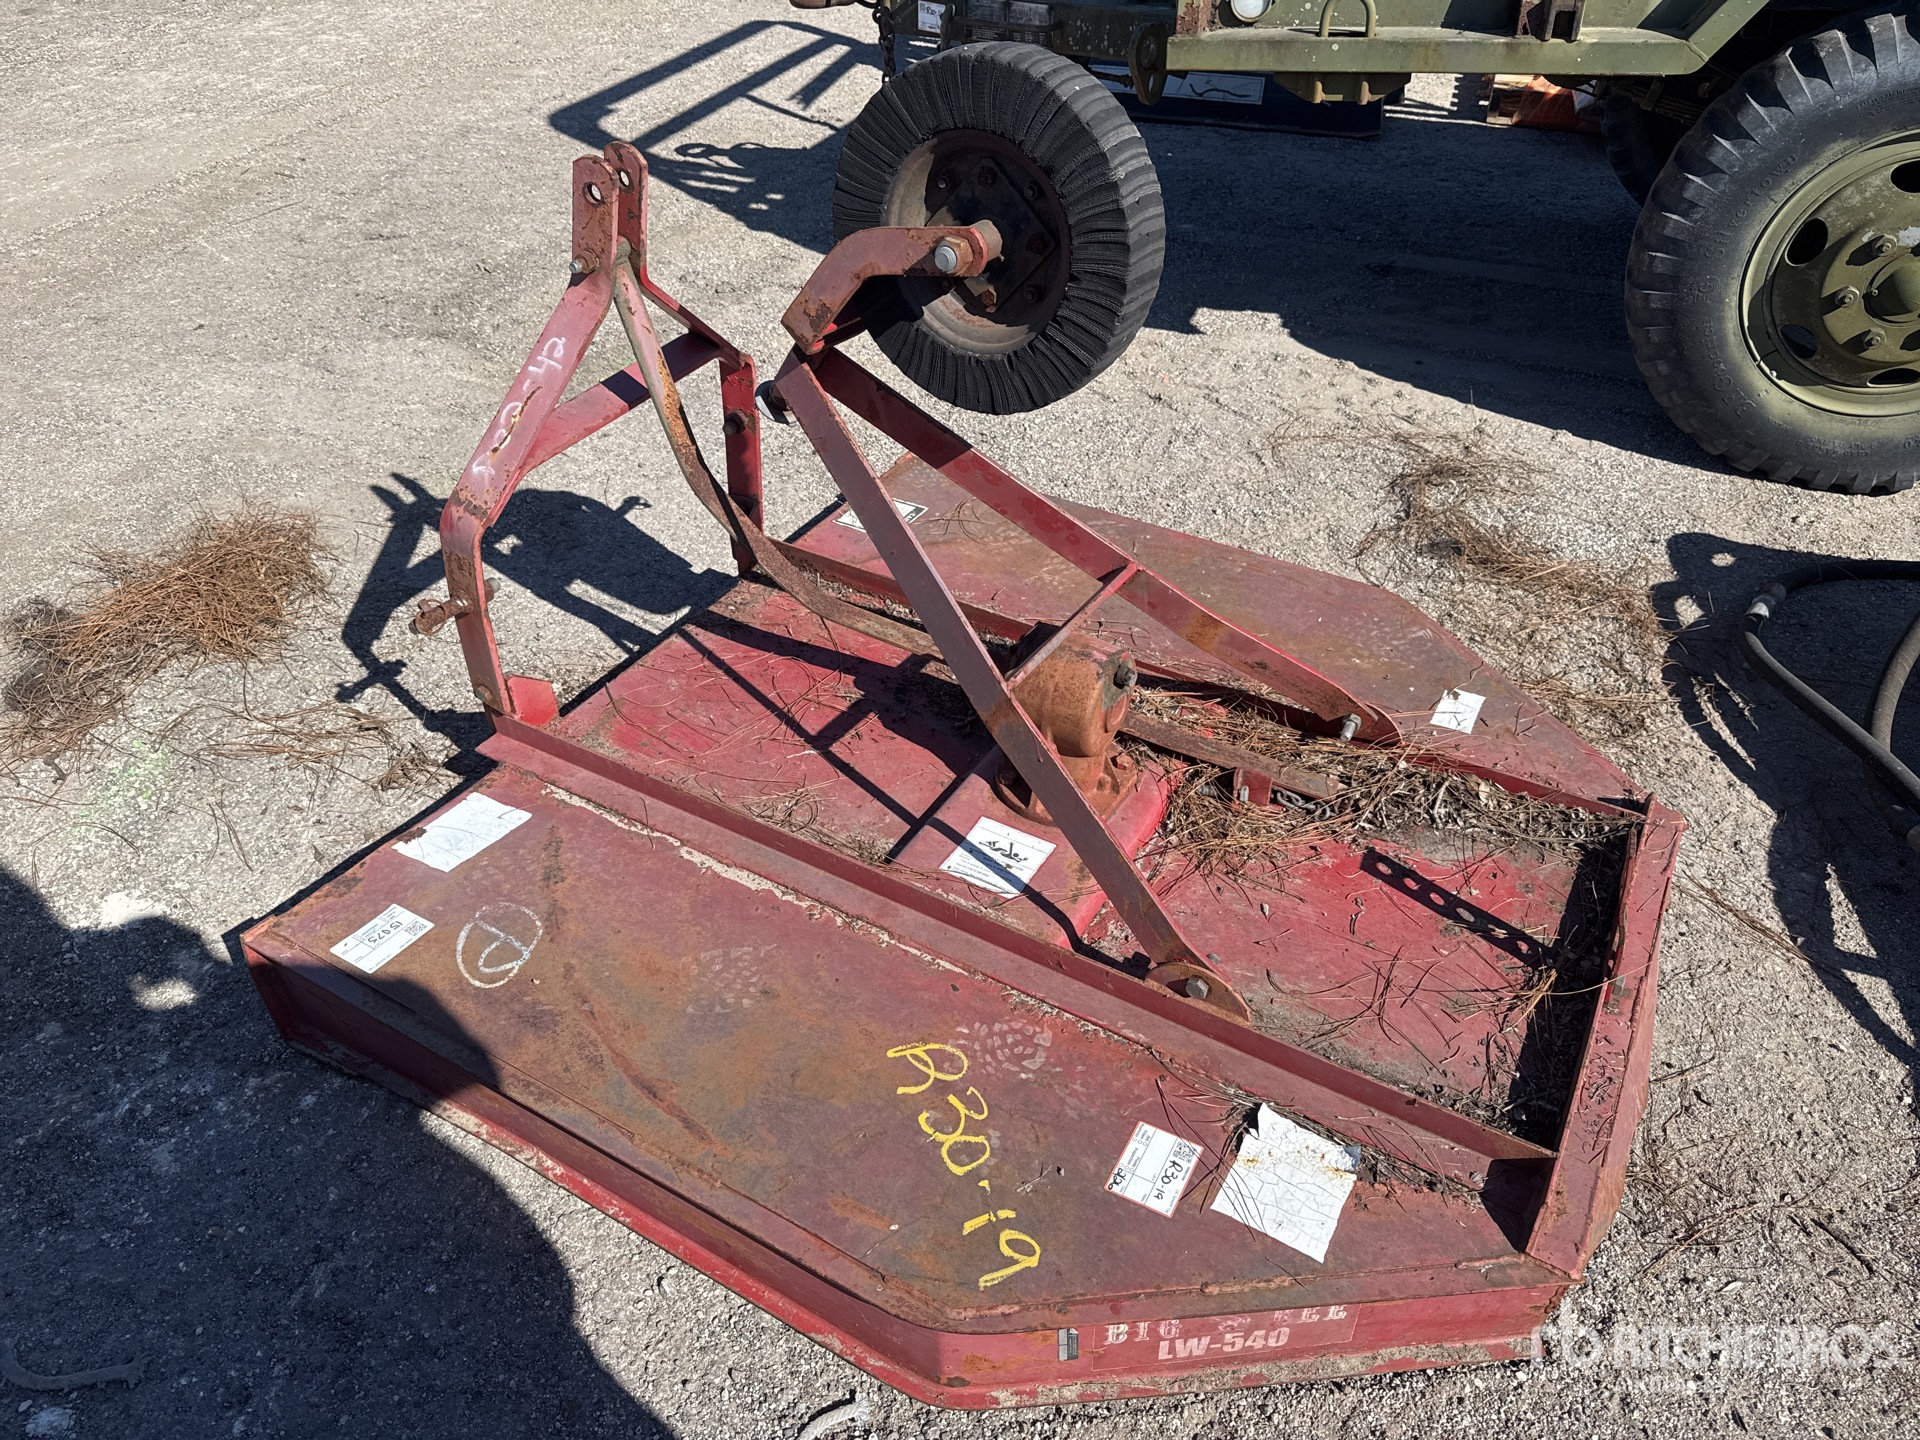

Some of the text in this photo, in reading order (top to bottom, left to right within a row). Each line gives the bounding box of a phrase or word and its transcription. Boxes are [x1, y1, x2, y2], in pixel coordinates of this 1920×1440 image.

[886, 1041, 1042, 1291] R30-19
[1153, 1159, 1184, 1201] R30-19
[1103, 1319, 1182, 1345] BIG
[1157, 1326, 1290, 1360] LW-540
